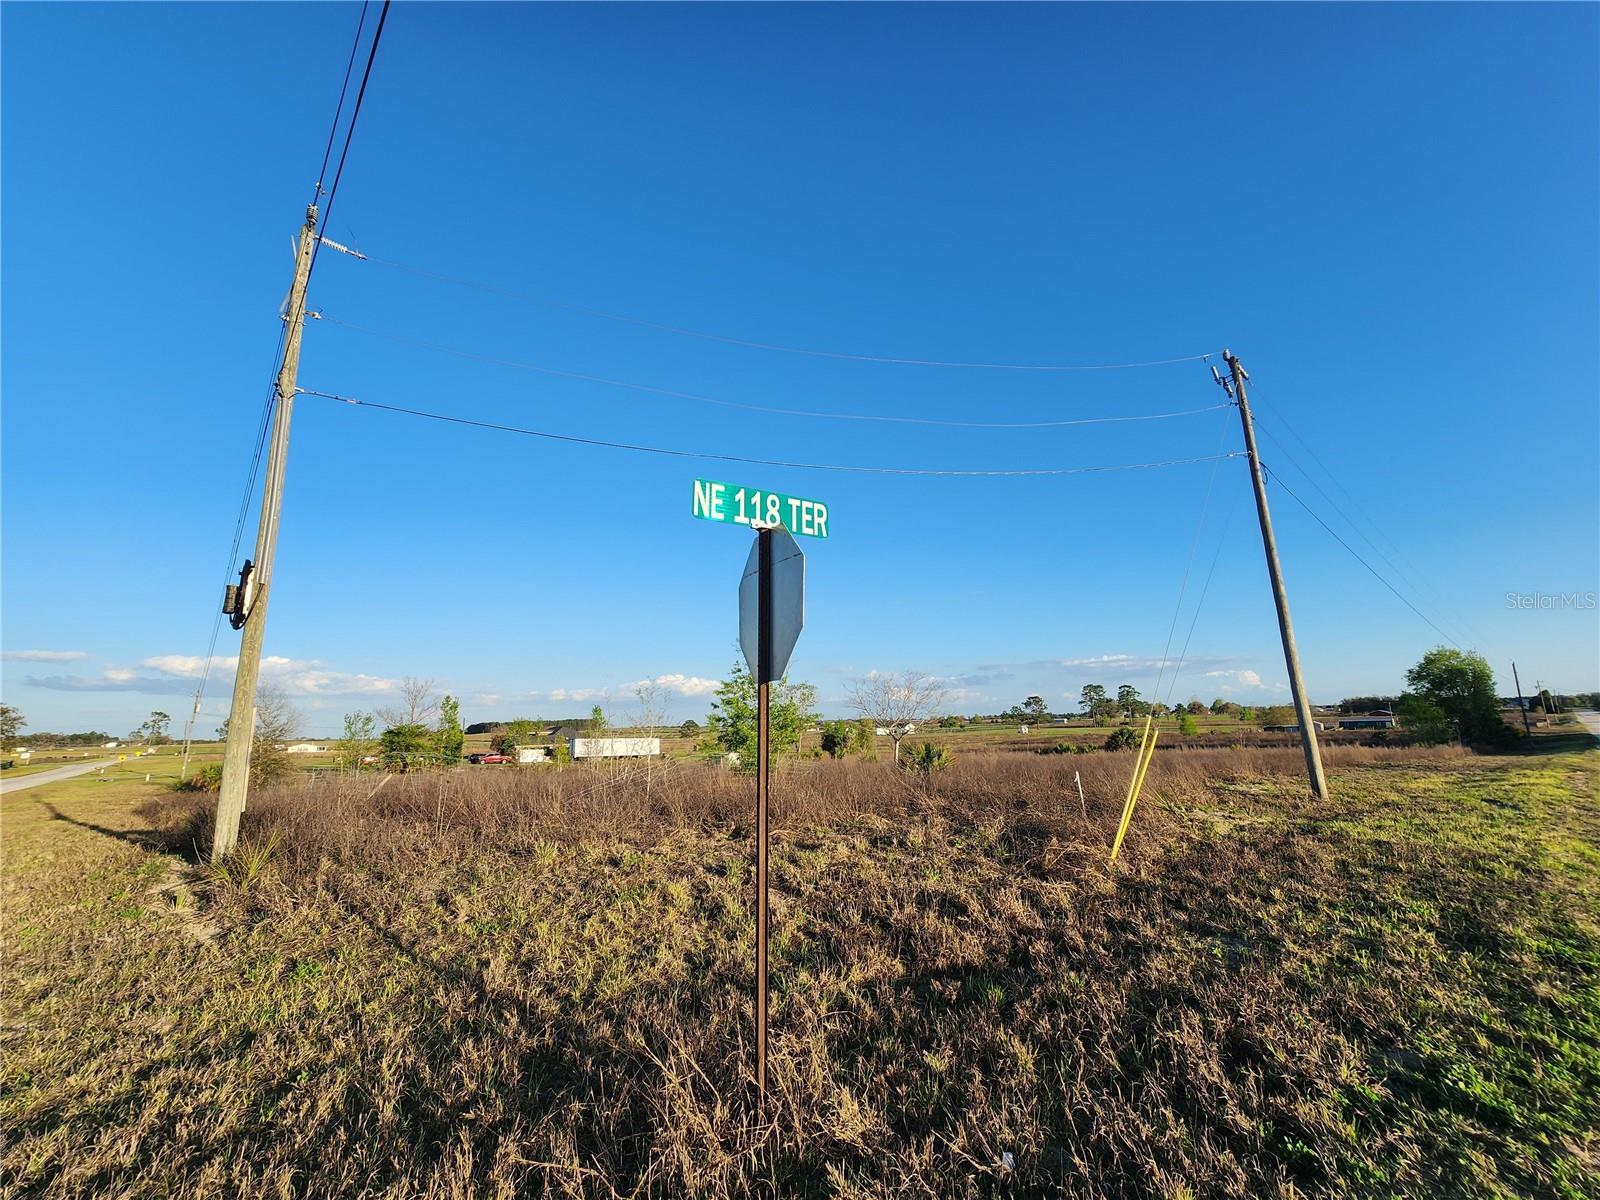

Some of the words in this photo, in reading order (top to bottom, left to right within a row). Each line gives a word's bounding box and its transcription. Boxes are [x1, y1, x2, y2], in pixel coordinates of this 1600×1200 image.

[693, 480, 726, 521] NE
[734, 488, 781, 528] 118
[787, 498, 828, 537] TER
